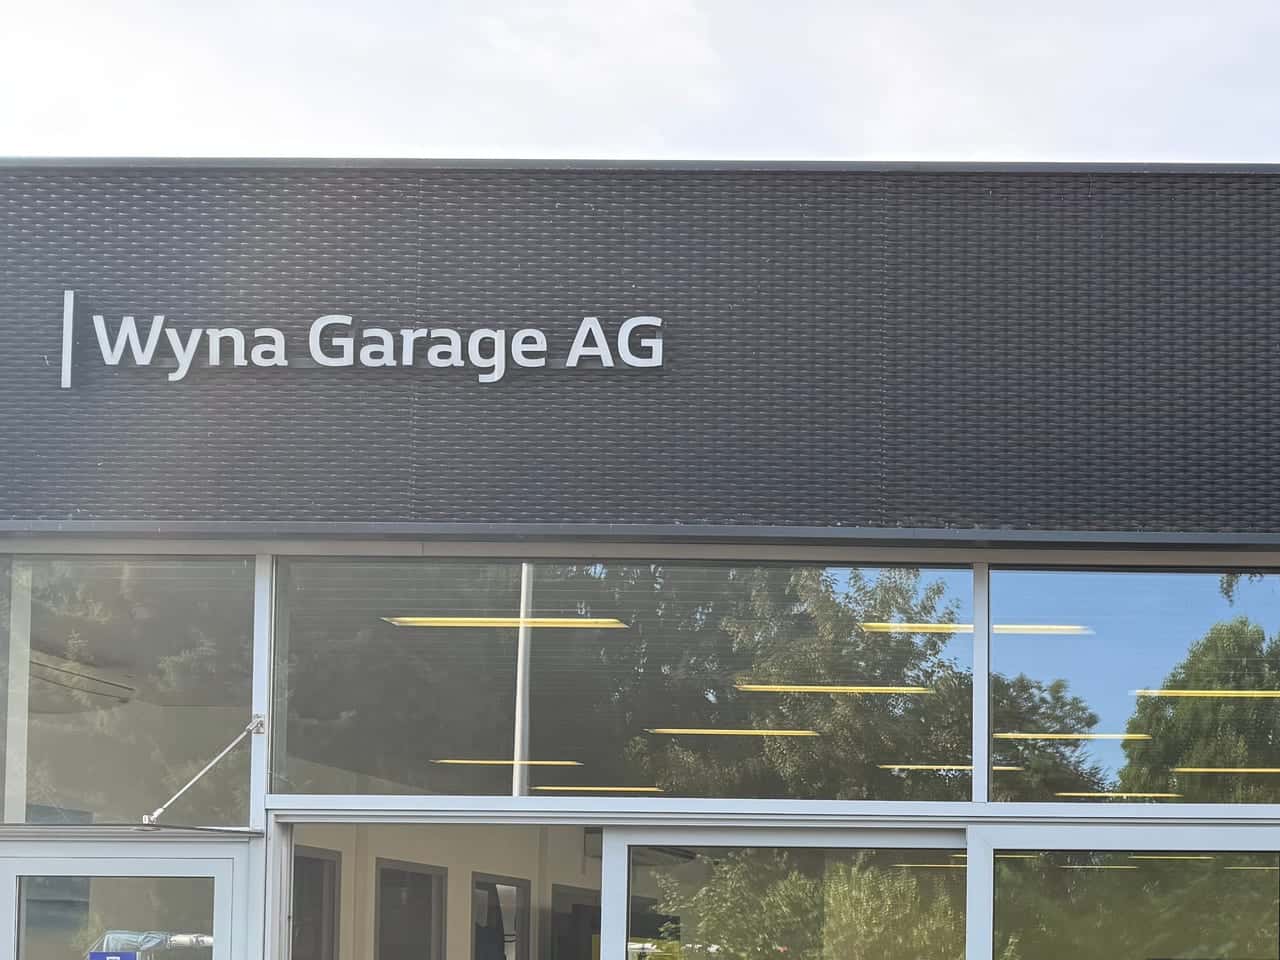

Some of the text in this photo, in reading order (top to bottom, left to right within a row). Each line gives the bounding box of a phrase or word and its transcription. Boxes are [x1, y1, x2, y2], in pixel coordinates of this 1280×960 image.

[92, 314, 664, 383] Wyna Garage AG
